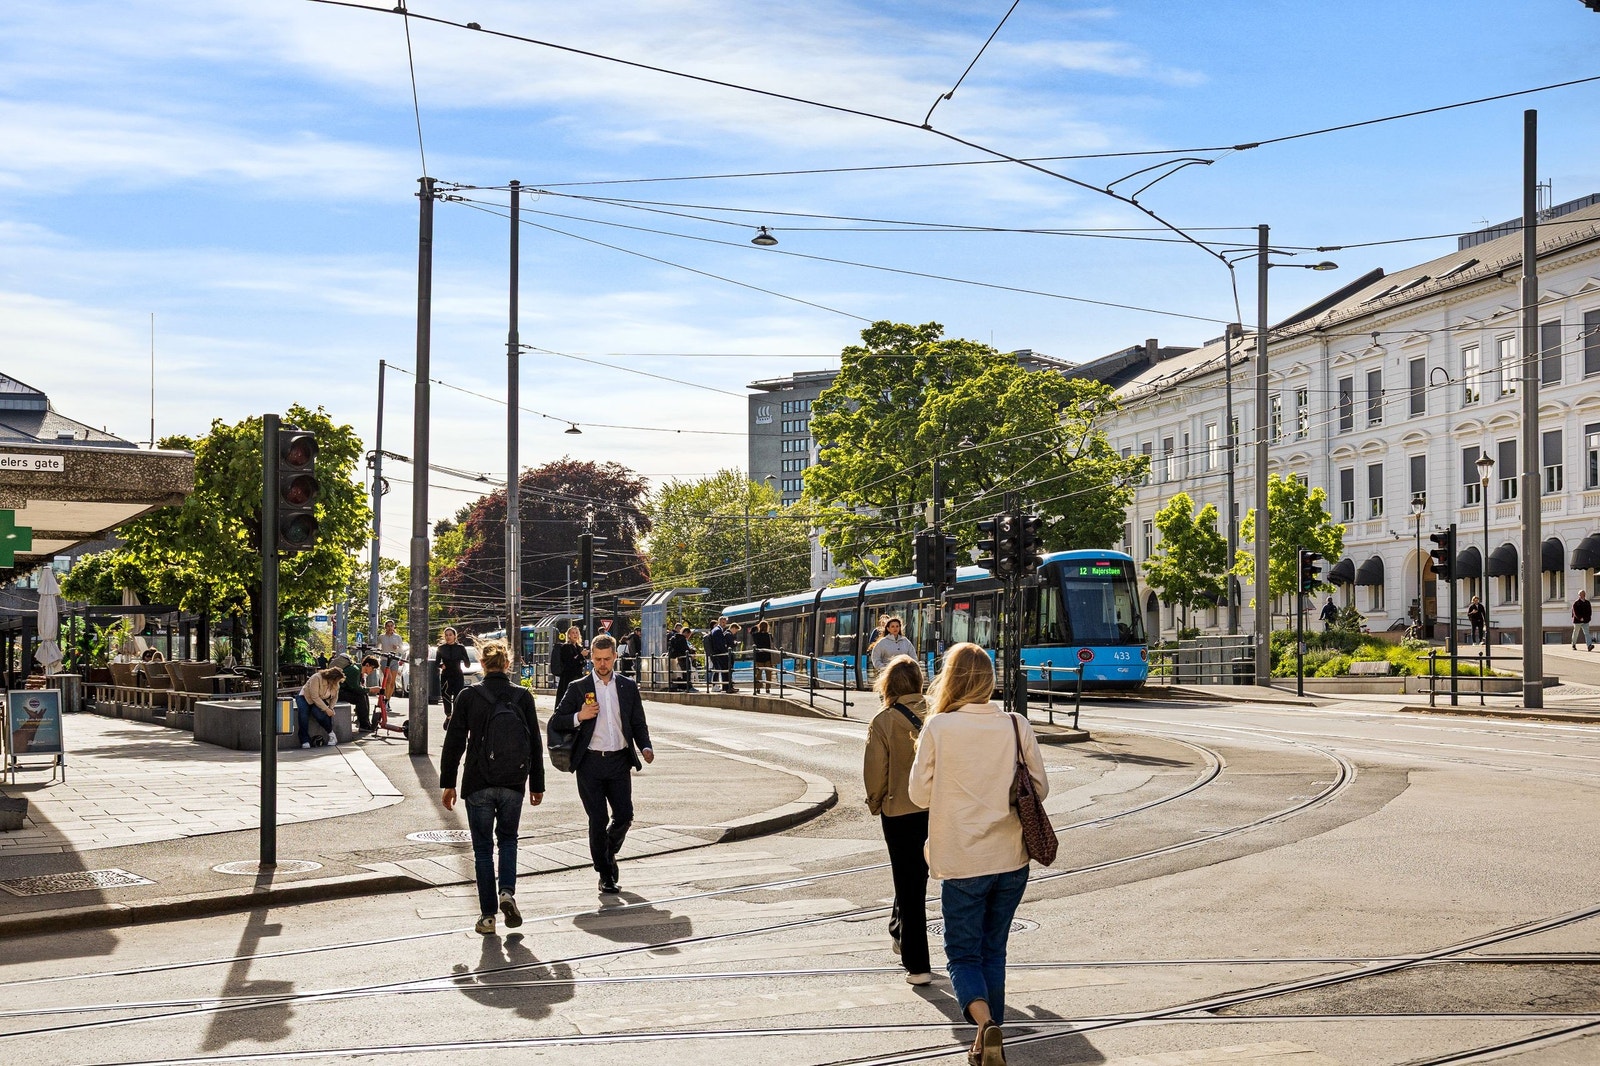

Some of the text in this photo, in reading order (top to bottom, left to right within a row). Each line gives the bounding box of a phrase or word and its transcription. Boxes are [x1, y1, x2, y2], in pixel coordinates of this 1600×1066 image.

[1, 457, 59, 469] elers gate
[1080, 567, 1087, 575] 12
[1114, 651, 1130, 660] 433
